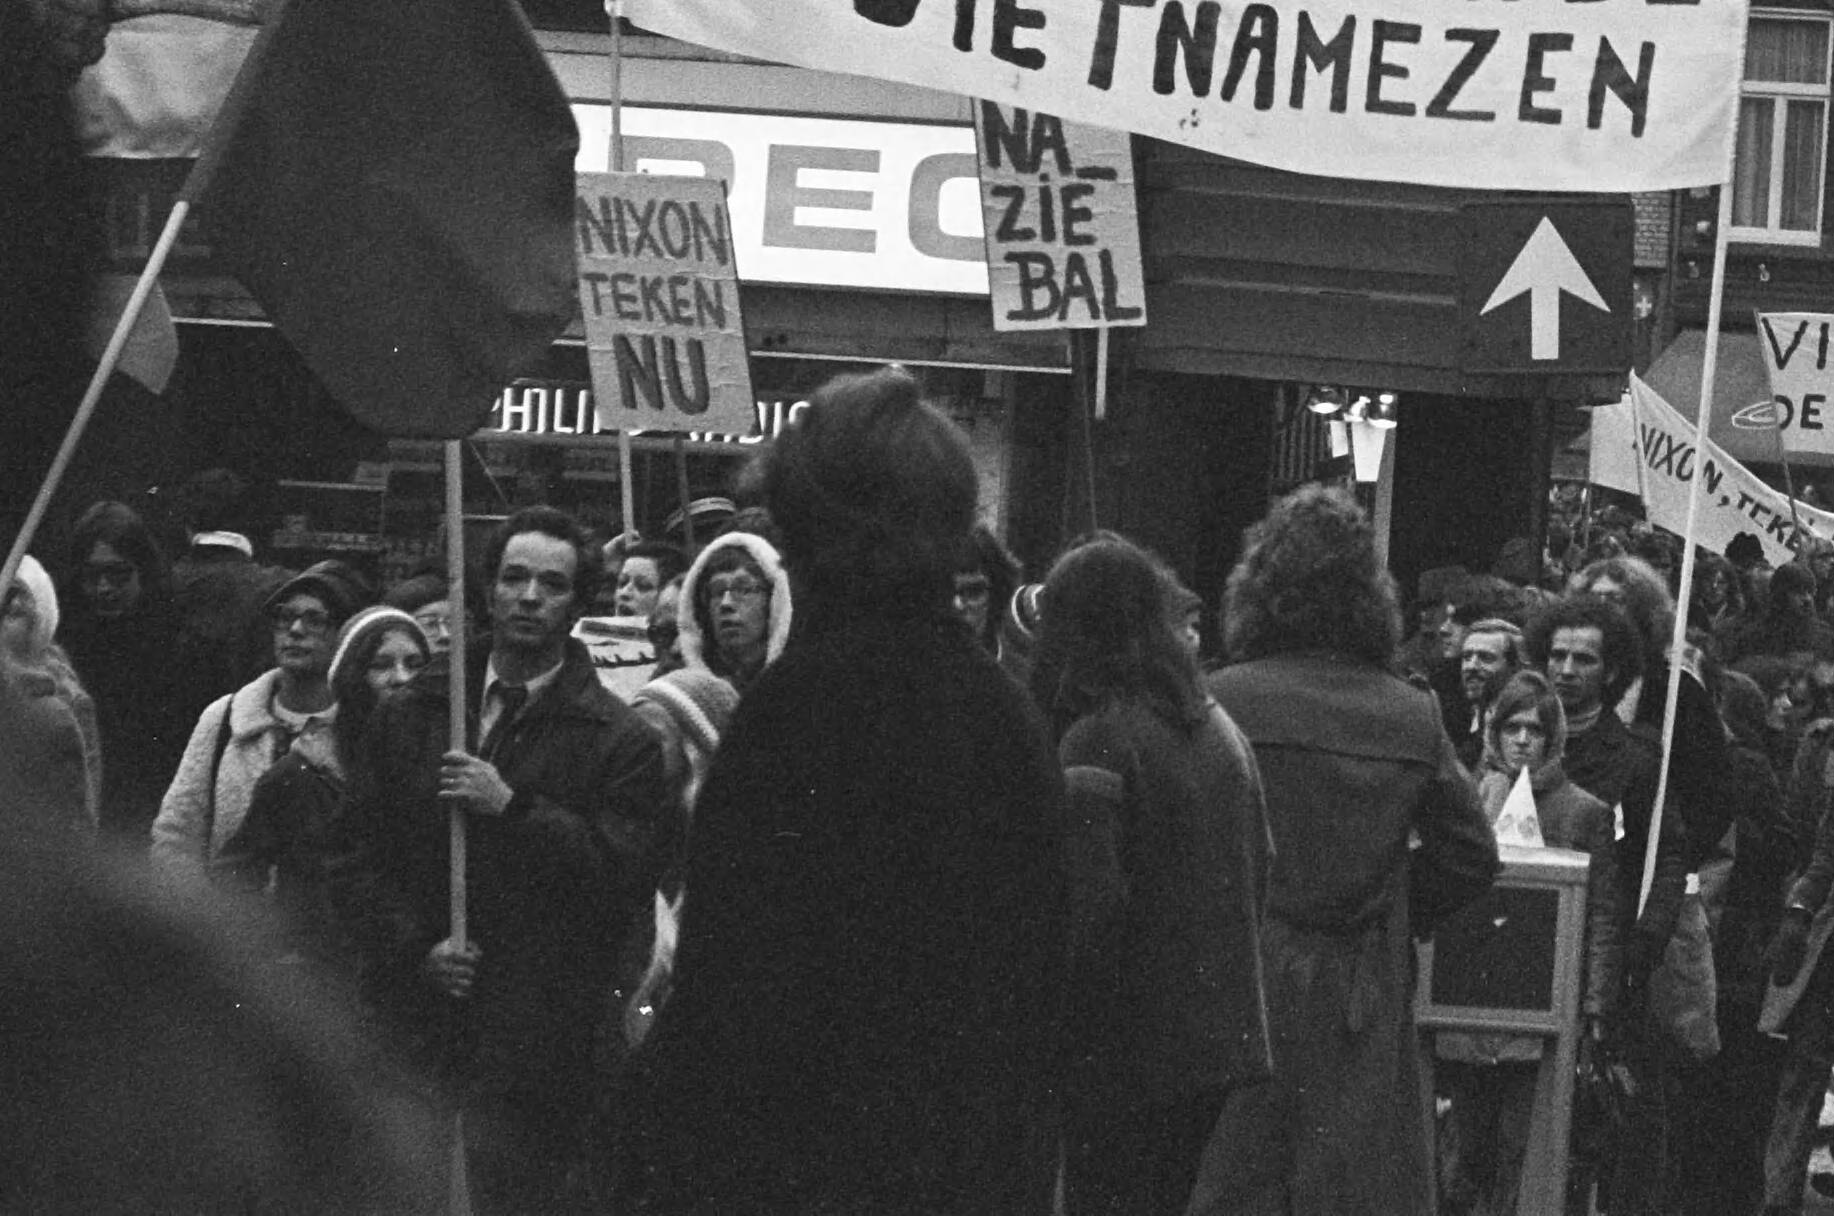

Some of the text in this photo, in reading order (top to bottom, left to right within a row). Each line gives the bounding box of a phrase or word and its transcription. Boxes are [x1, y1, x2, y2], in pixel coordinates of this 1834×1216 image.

[574, 195, 729, 267] NIXON
[581, 272, 727, 330] TEKEN
[1002, 249, 1143, 321] BAL
[612, 334, 711, 417] NU
